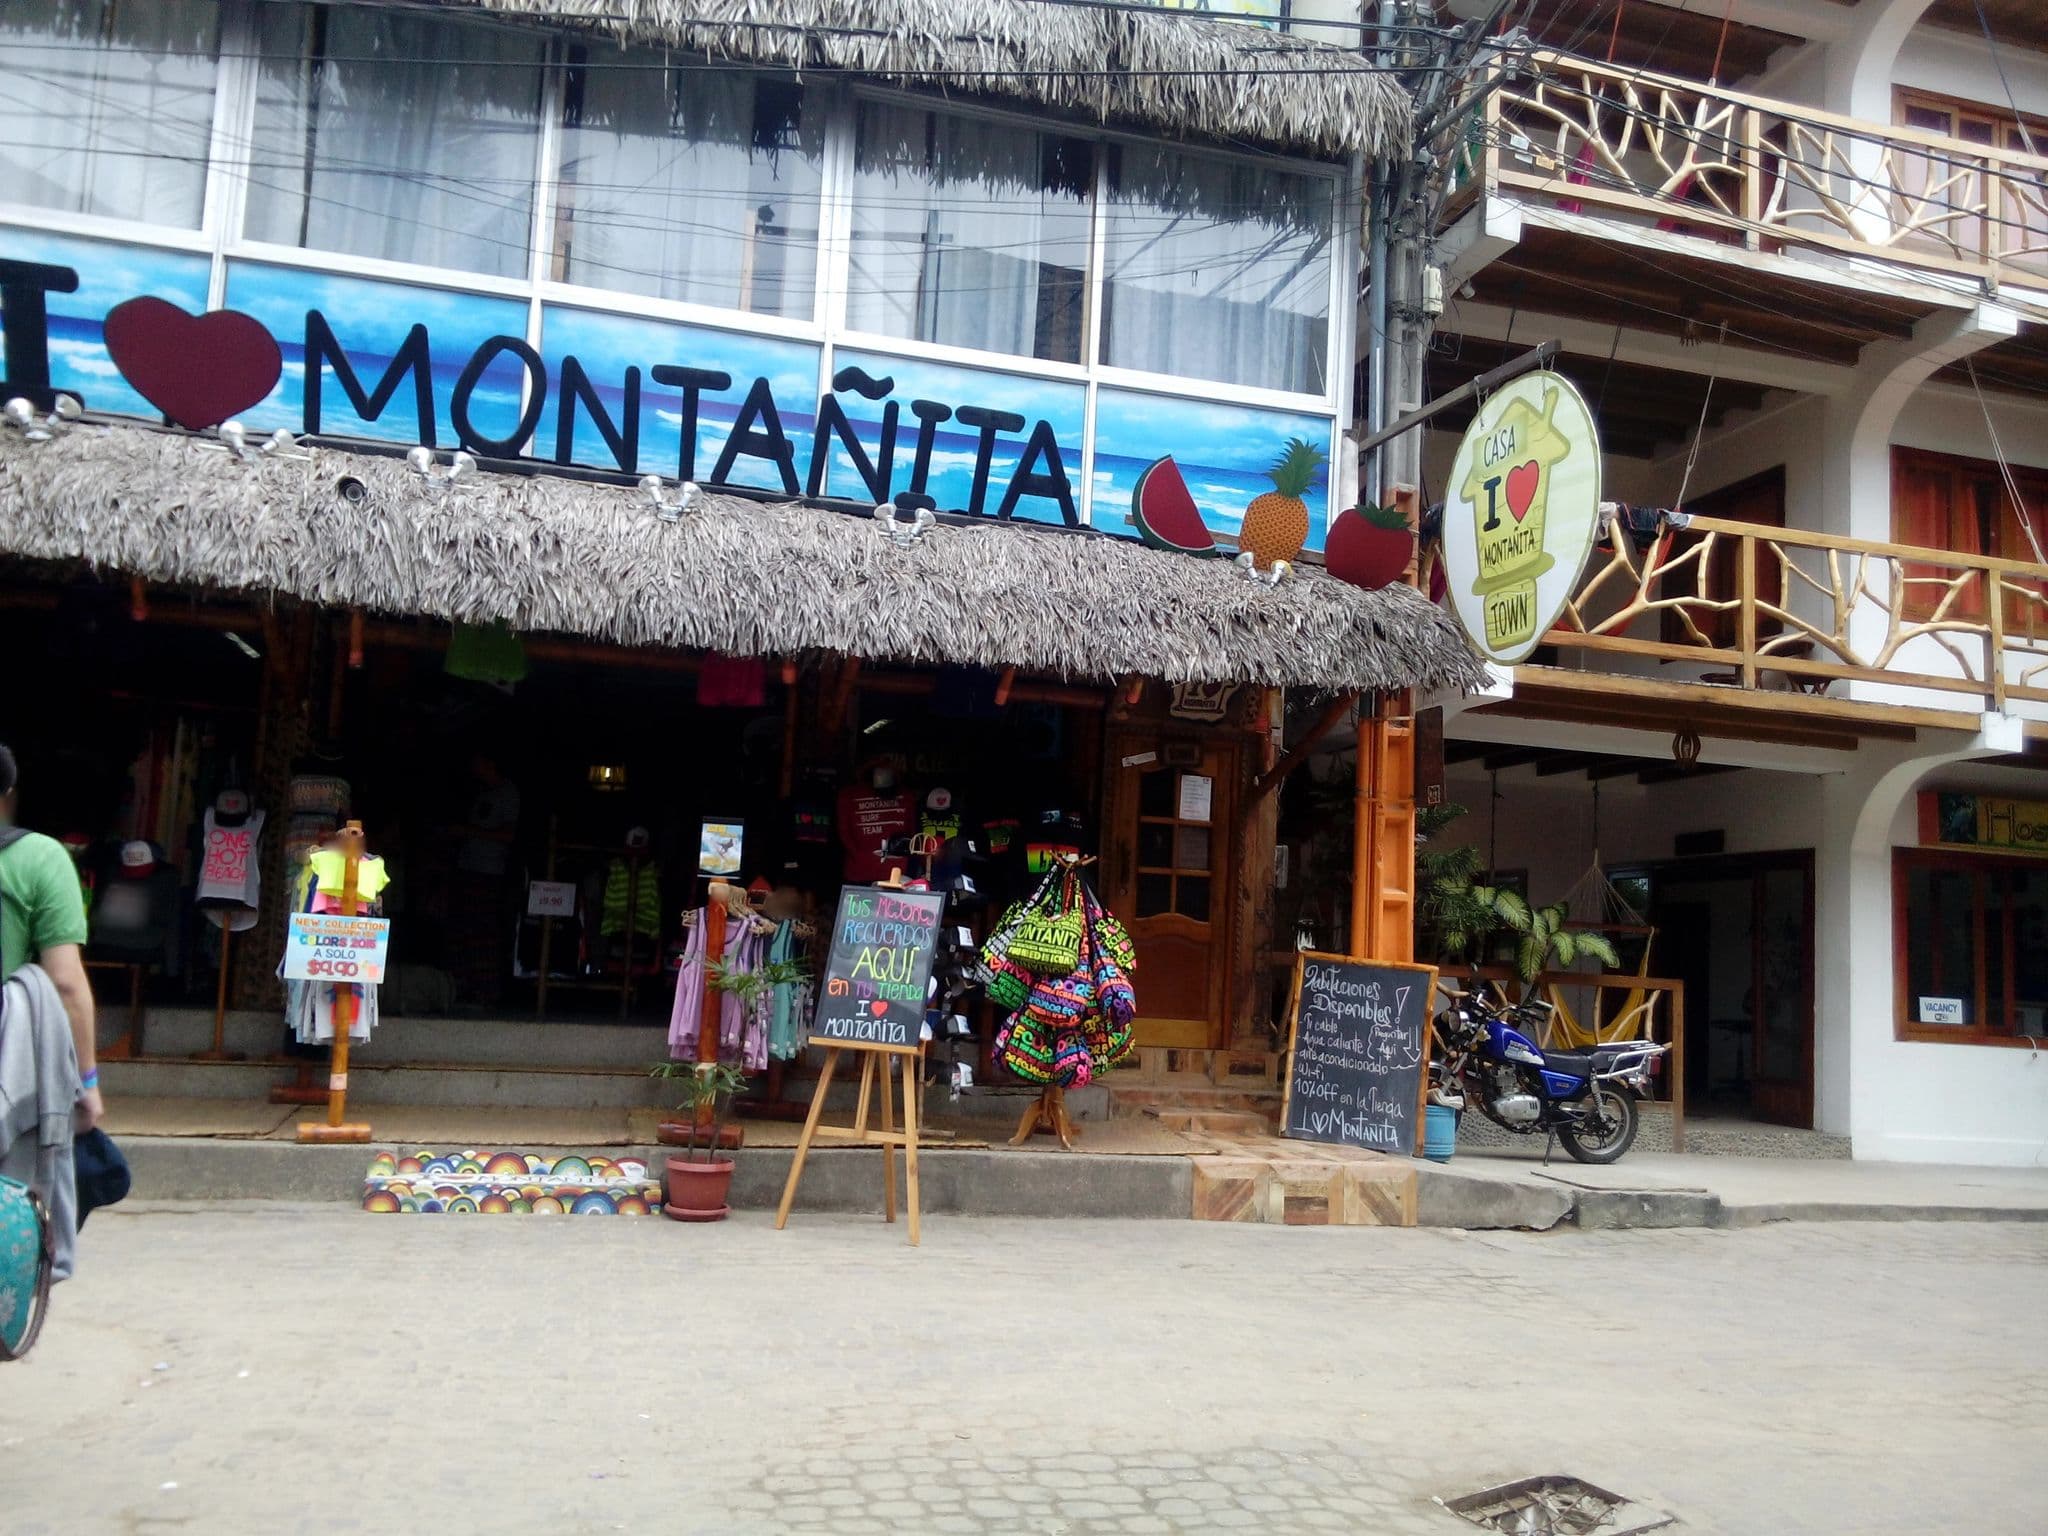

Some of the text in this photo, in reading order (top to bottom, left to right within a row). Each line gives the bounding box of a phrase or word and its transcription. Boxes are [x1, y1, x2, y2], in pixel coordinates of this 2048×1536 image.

[0, 259, 1079, 528] I MONTAÑITA
[1484, 424, 1516, 467] CASA
[1483, 476, 1501, 532] I
[1484, 527, 1535, 568] MONTAÑITA
[1491, 593, 1527, 639] TOWN
[209, 829, 251, 849] ONE
[863, 826, 884, 835] TEAM
[208, 849, 248, 866] HOT
[296, 917, 386, 931] NEW COLLECTION
[300, 934, 347, 947] COLORS
[314, 948, 356, 959] A SOLO
[828, 978, 849, 996] en
[856, 1000, 870, 1016] I
[1925, 1003, 1958, 1013] VACANCY
[1315, 1018, 1338, 1033] cable
[1327, 1031, 1363, 1054] caliente
[1341, 1094, 1352, 1105] en
[1356, 1087, 1368, 1111] la
